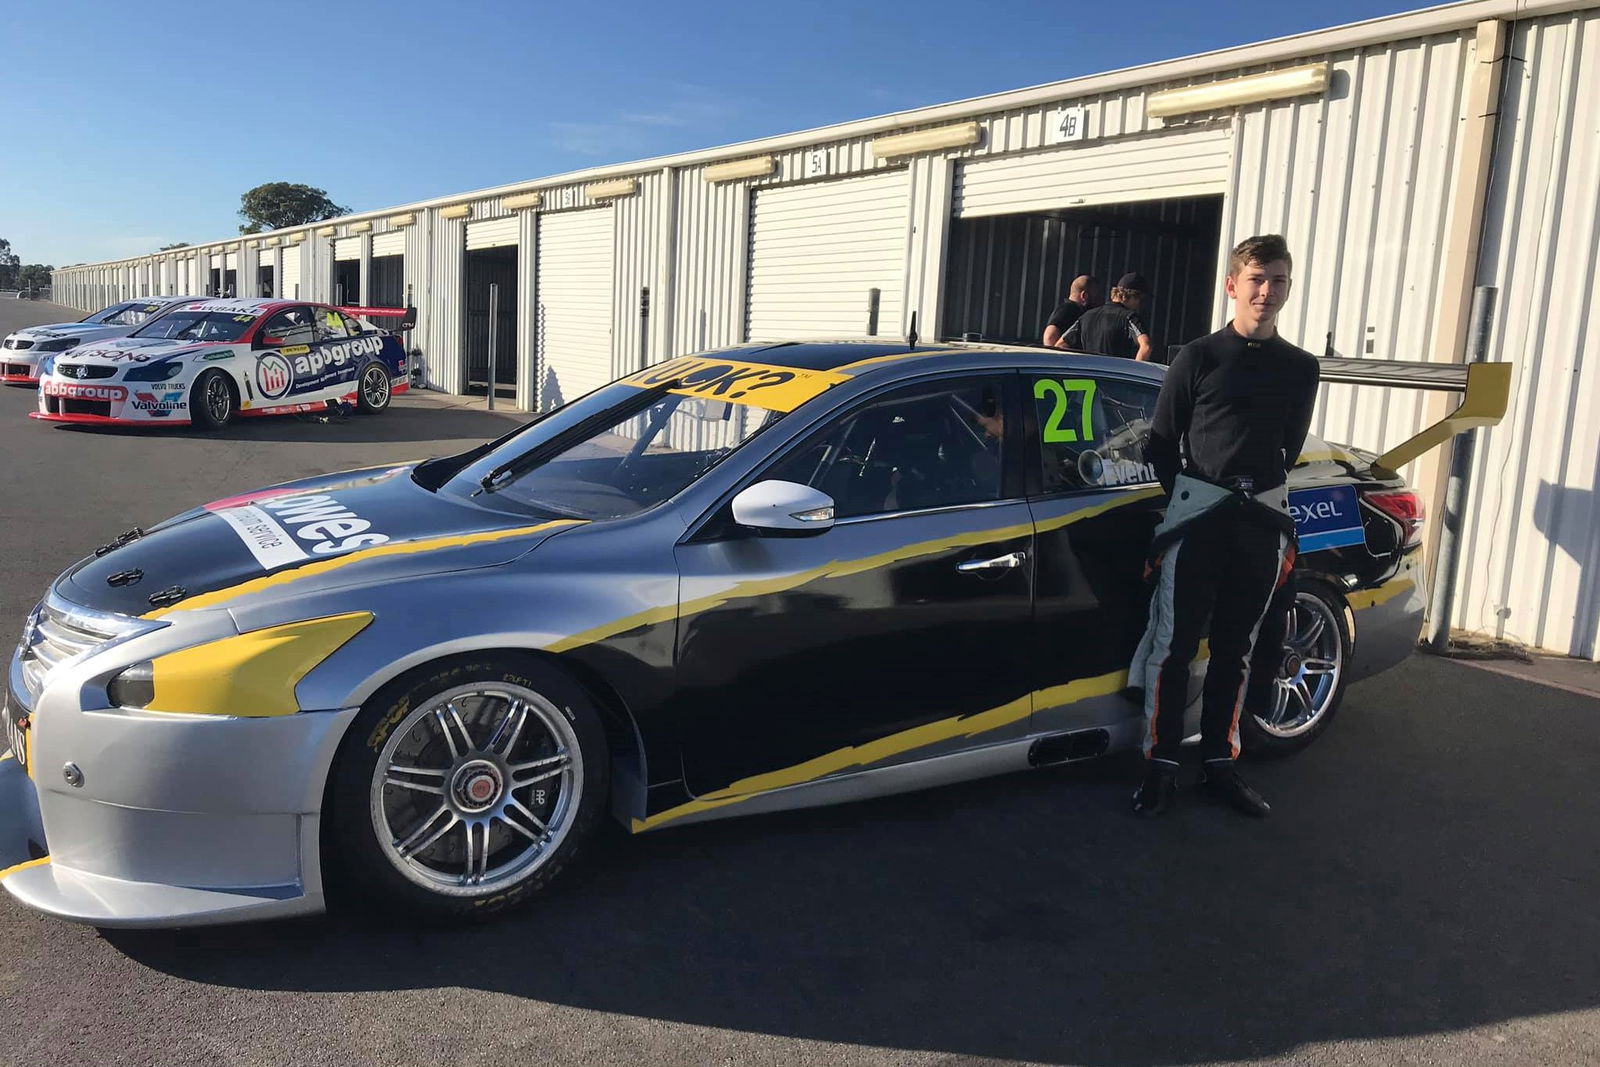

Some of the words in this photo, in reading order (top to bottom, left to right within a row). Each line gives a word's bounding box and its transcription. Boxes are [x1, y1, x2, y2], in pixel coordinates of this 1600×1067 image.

[1059, 113, 1077, 137] 4B
[295, 335, 384, 375] apbgroup
[131, 400, 187, 411] Valvoline
[1033, 379, 1097, 443] 27
[247, 523, 282, 549] service
[262, 494, 390, 554] owes
